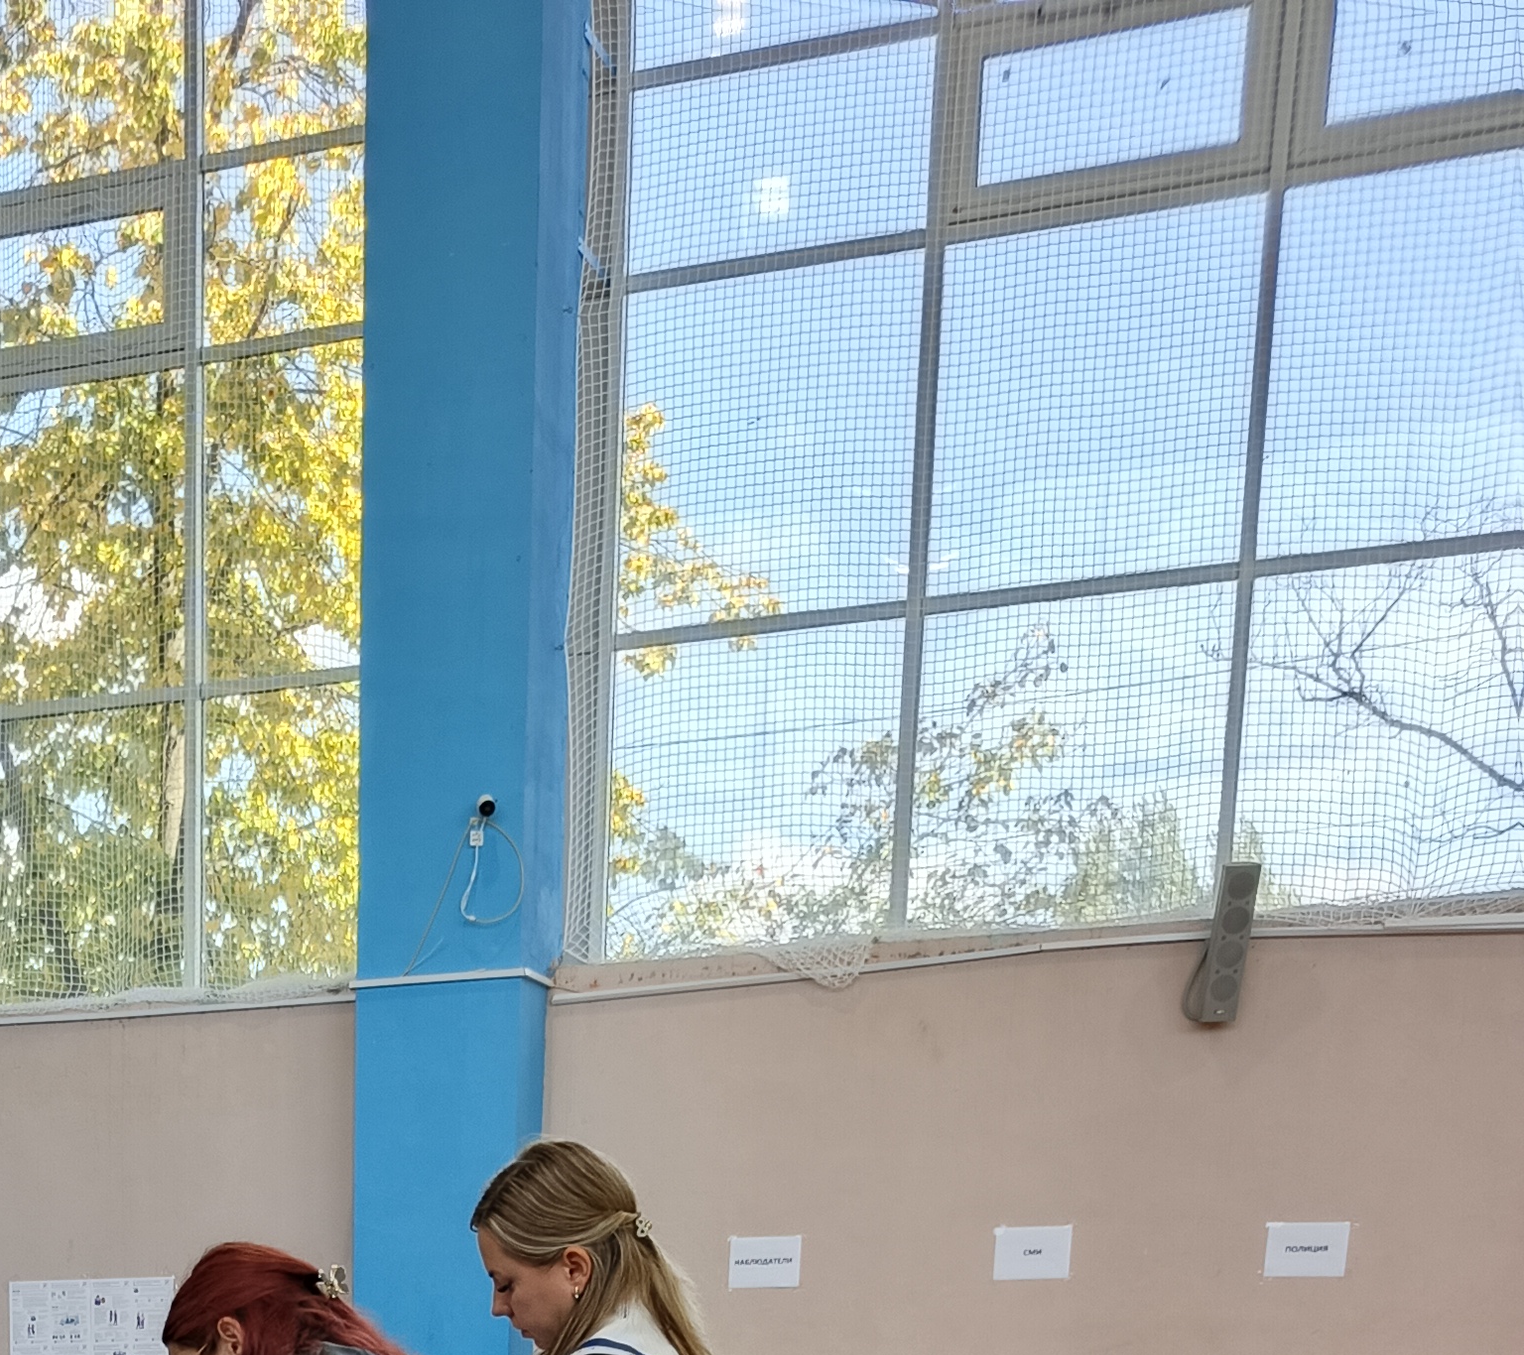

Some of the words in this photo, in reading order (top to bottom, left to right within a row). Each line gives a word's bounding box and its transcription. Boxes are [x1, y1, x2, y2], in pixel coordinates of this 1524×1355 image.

[1023, 1248, 1043, 1257] СМИ
[1284, 1244, 1329, 1255] ПОЛИЦИЯ
[734, 1257, 793, 1266] НАБЛЮДАТЕЛИ
